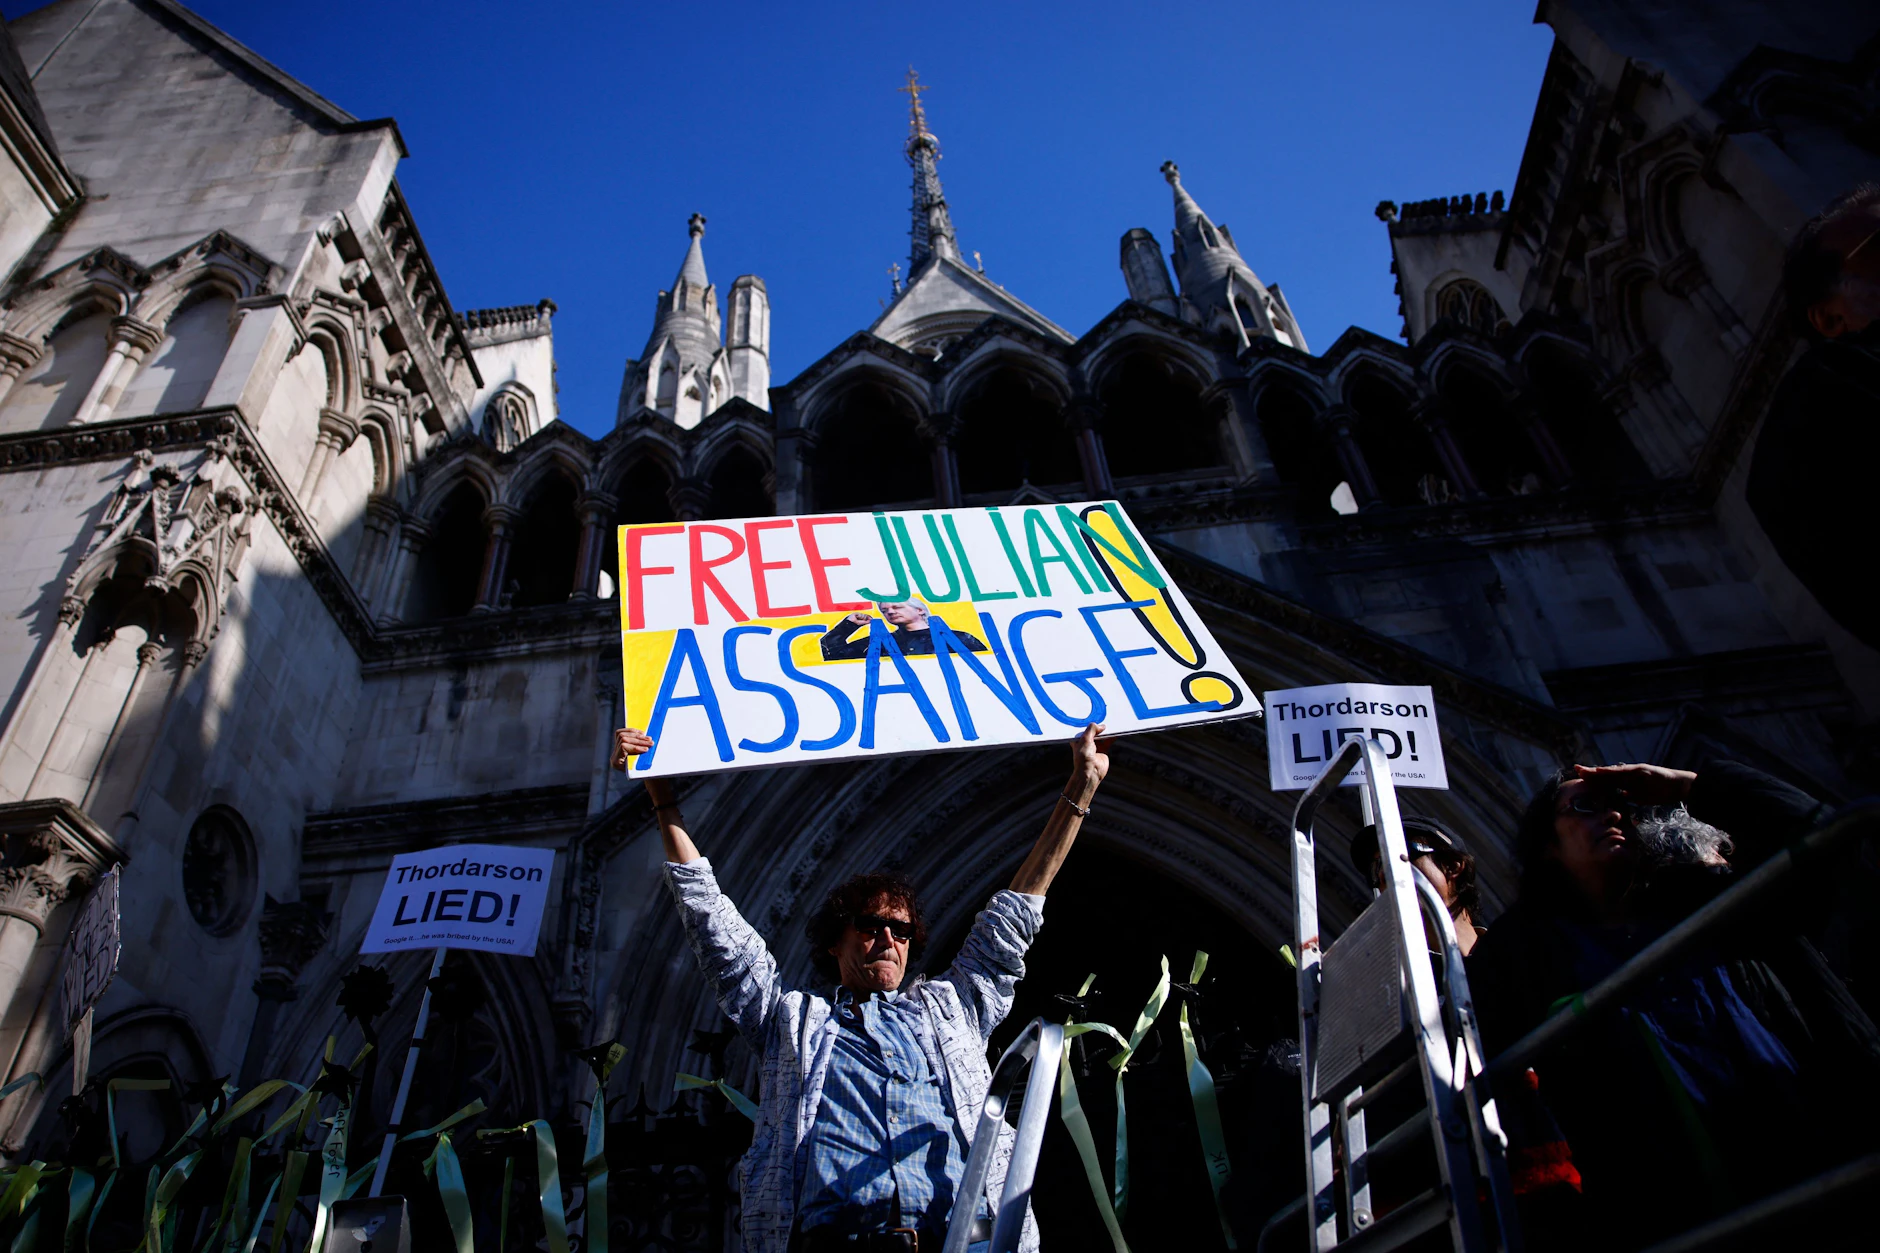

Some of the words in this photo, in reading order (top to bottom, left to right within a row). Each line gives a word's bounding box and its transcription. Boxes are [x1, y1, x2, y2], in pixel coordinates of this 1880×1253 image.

[625, 516, 872, 630] FREE
[855, 502, 1167, 602] JULIAN
[635, 504, 1243, 771] ASSANGE!
[1272, 697, 1428, 721] Thordarson
[396, 858, 543, 884] Thordarson
[392, 889, 521, 927] LIED!
[384, 936, 407, 945] Google
[447, 932, 470, 940] bribed
[472, 934, 481, 942] by
[482, 935, 494, 943] the
[496, 937, 515, 945] USA!
